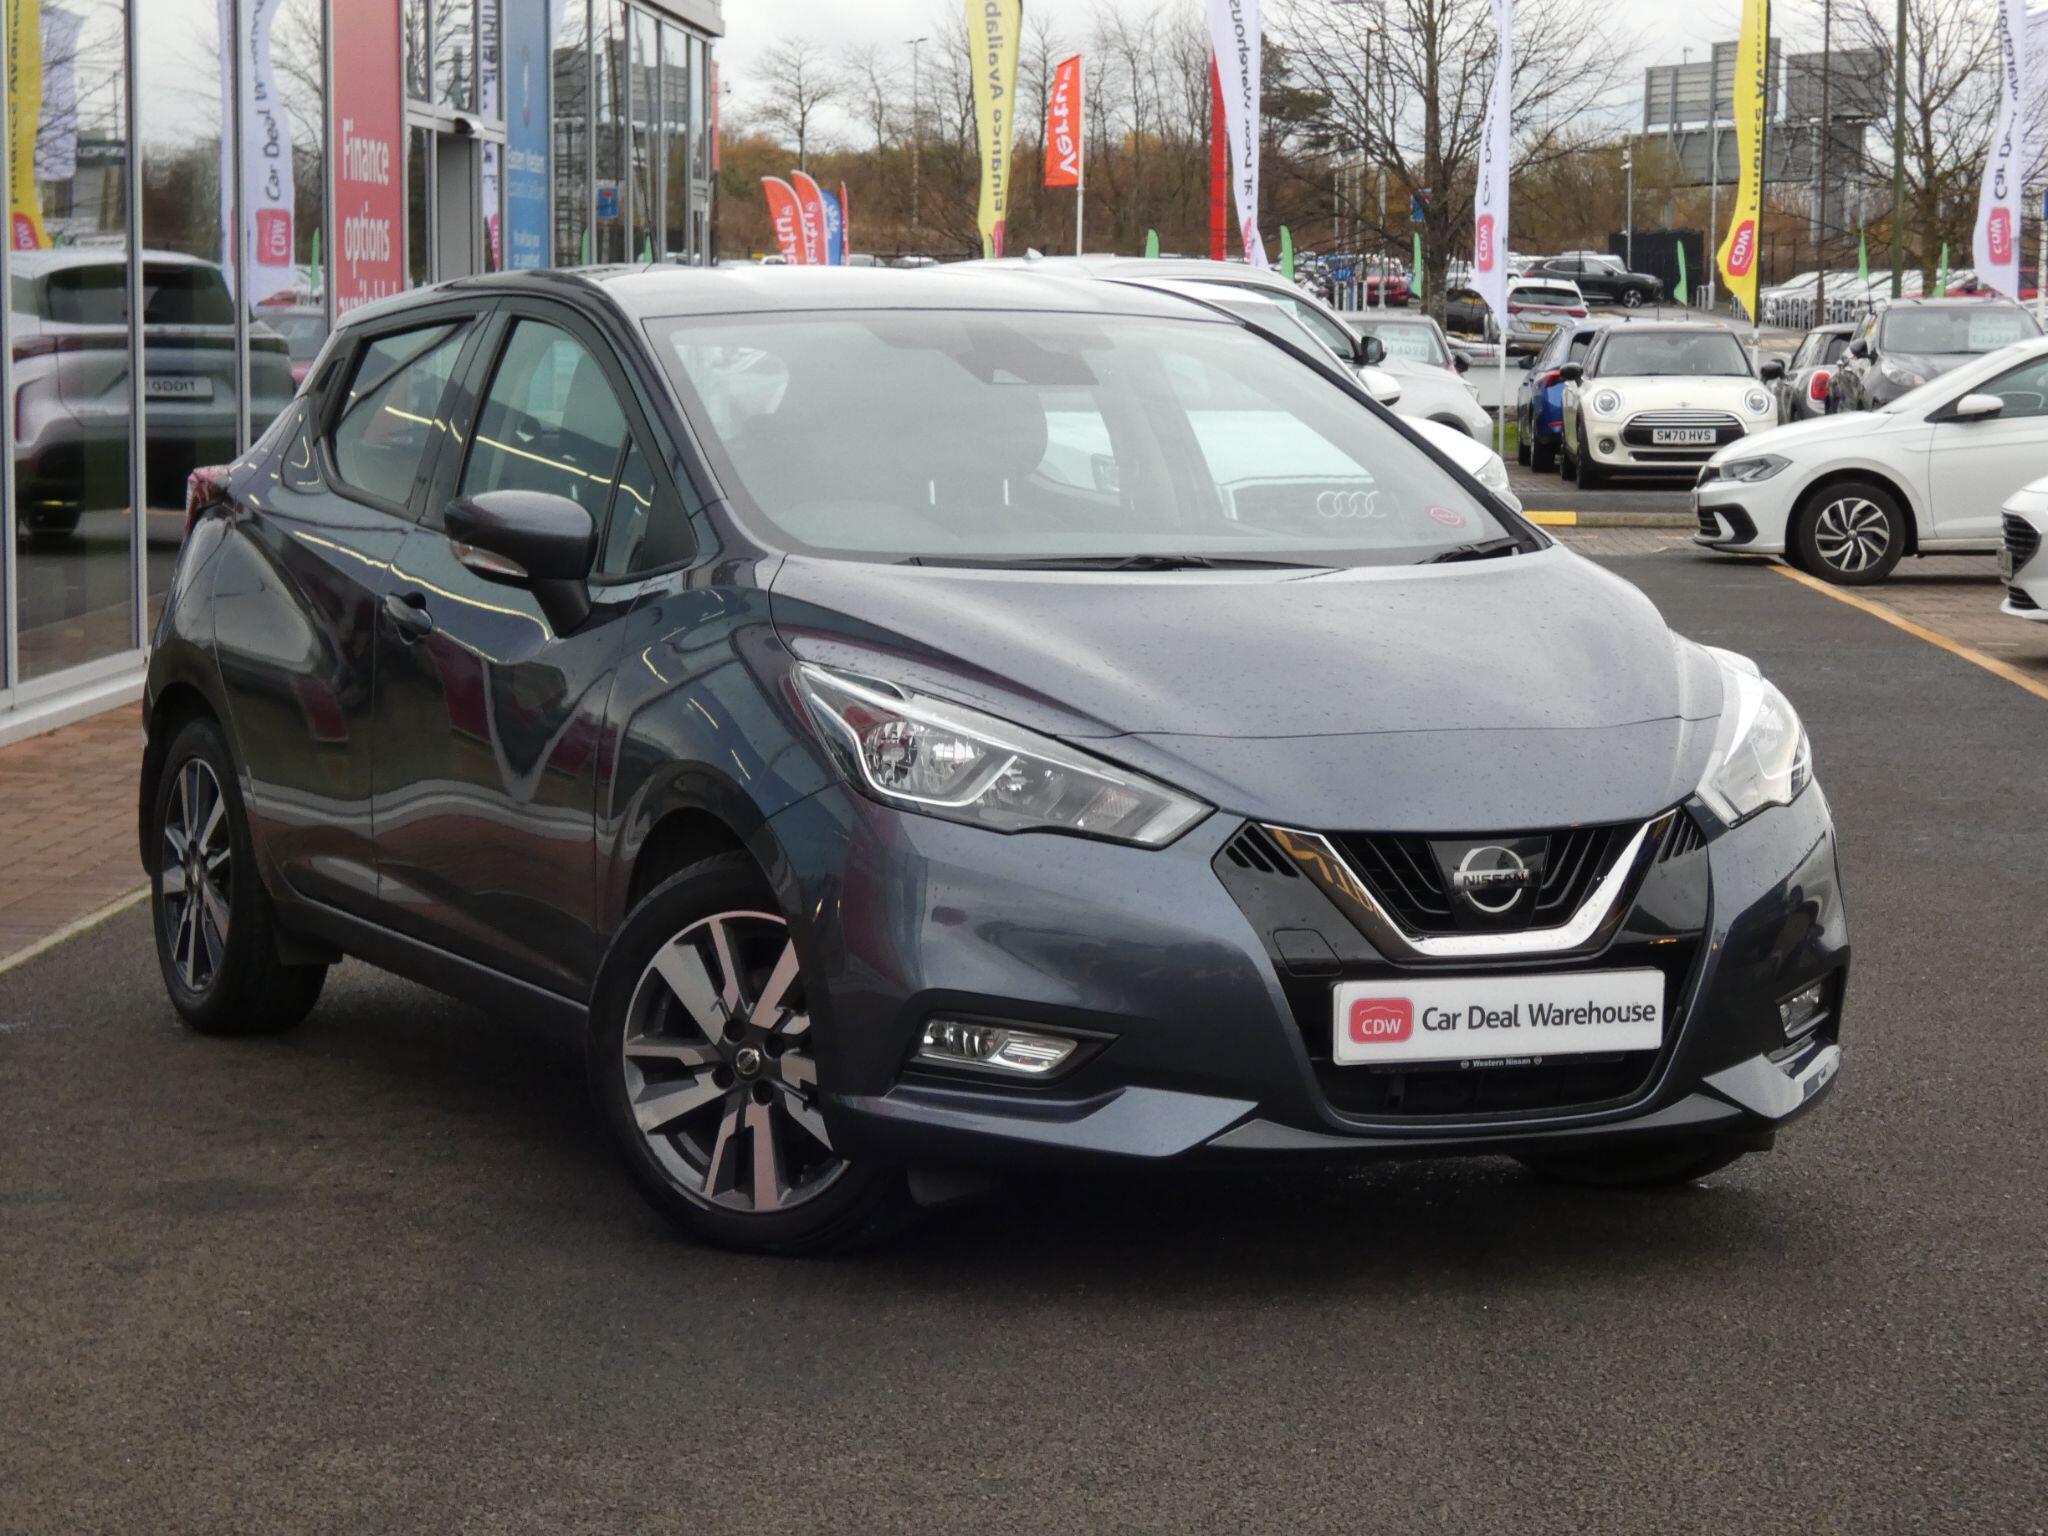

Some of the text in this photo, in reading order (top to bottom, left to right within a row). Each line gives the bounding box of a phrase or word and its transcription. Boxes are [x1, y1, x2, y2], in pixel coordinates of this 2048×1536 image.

[256, 109, 280, 158] Deal
[343, 118, 390, 185] Finance
[265, 168, 281, 201] Car
[271, 219, 287, 256] CDW
[344, 200, 391, 279] options
[1657, 430, 1711, 441] SM70 HVS
[1463, 872, 1526, 889] NISSAN
[1361, 1017, 1402, 1035] CDW
[1421, 1001, 1656, 1031] Car Deal Warehouse
[1473, 1058, 1531, 1068] Western Nissan
